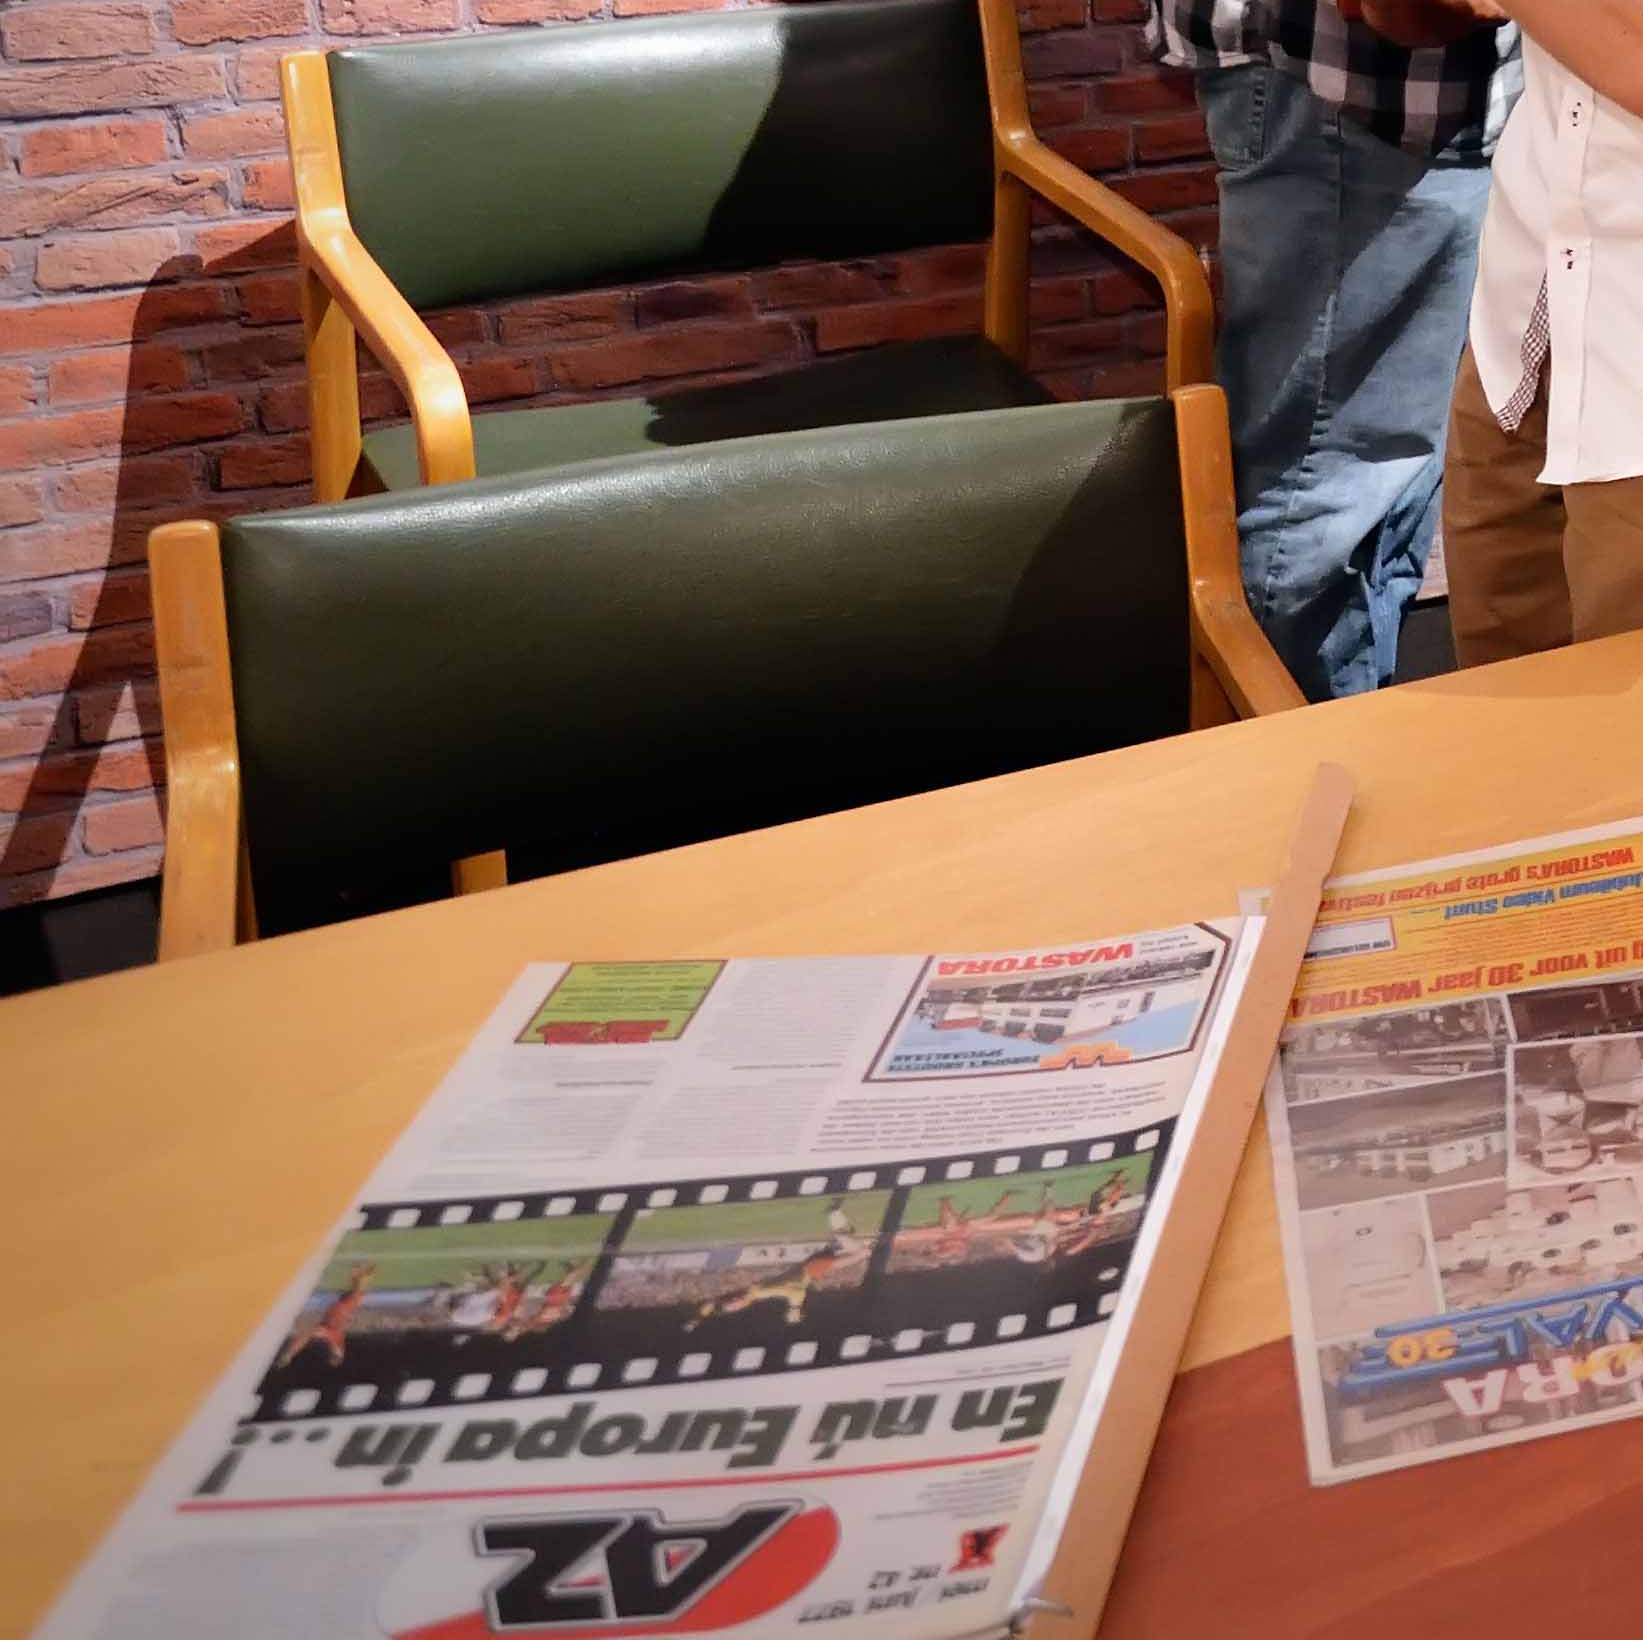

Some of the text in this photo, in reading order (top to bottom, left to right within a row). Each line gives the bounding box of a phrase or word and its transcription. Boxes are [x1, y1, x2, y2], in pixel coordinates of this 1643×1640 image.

[1389, 875, 1462, 904] prijzen
[1465, 865, 1521, 892] grote
[1443, 897, 1499, 921] Stunt
[1503, 887, 1556, 910] Video
[935, 941, 1135, 978] WASTORA
[1529, 952, 1588, 977] voor
[1594, 948, 1628, 970] uit
[1428, 966, 1484, 996] jaar
[1488, 962, 1526, 987] 30
[1387, 1326, 1458, 1367] 30
[950, 1376, 1065, 1443] En
[442, 1402, 801, 1470] Europa
[809, 1393, 940, 1461] nú
[472, 1500, 803, 1632] AZ
